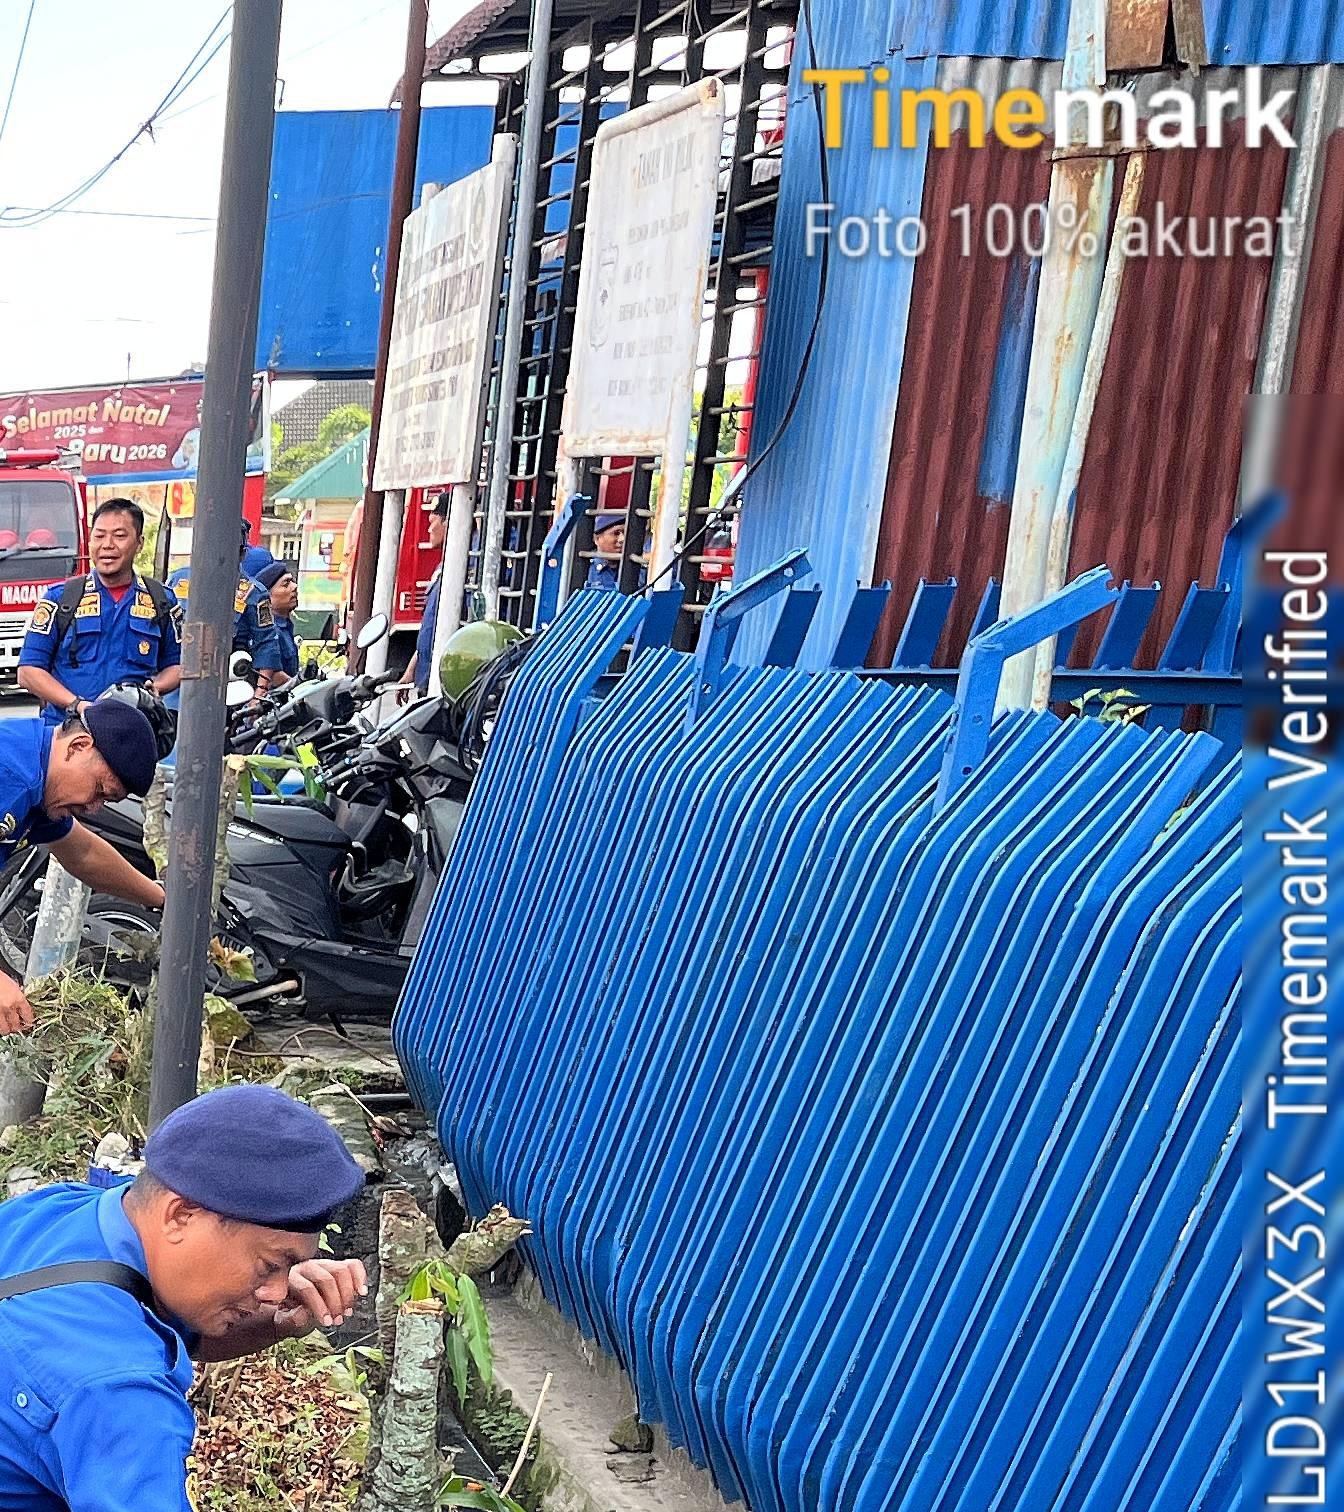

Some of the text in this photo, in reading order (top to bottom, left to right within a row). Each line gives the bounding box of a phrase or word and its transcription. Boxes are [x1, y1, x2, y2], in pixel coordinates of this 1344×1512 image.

[1, 396, 171, 439] Selamat Natal
[53, 424, 87, 439] 2025
[127, 443, 168, 461] 2026
